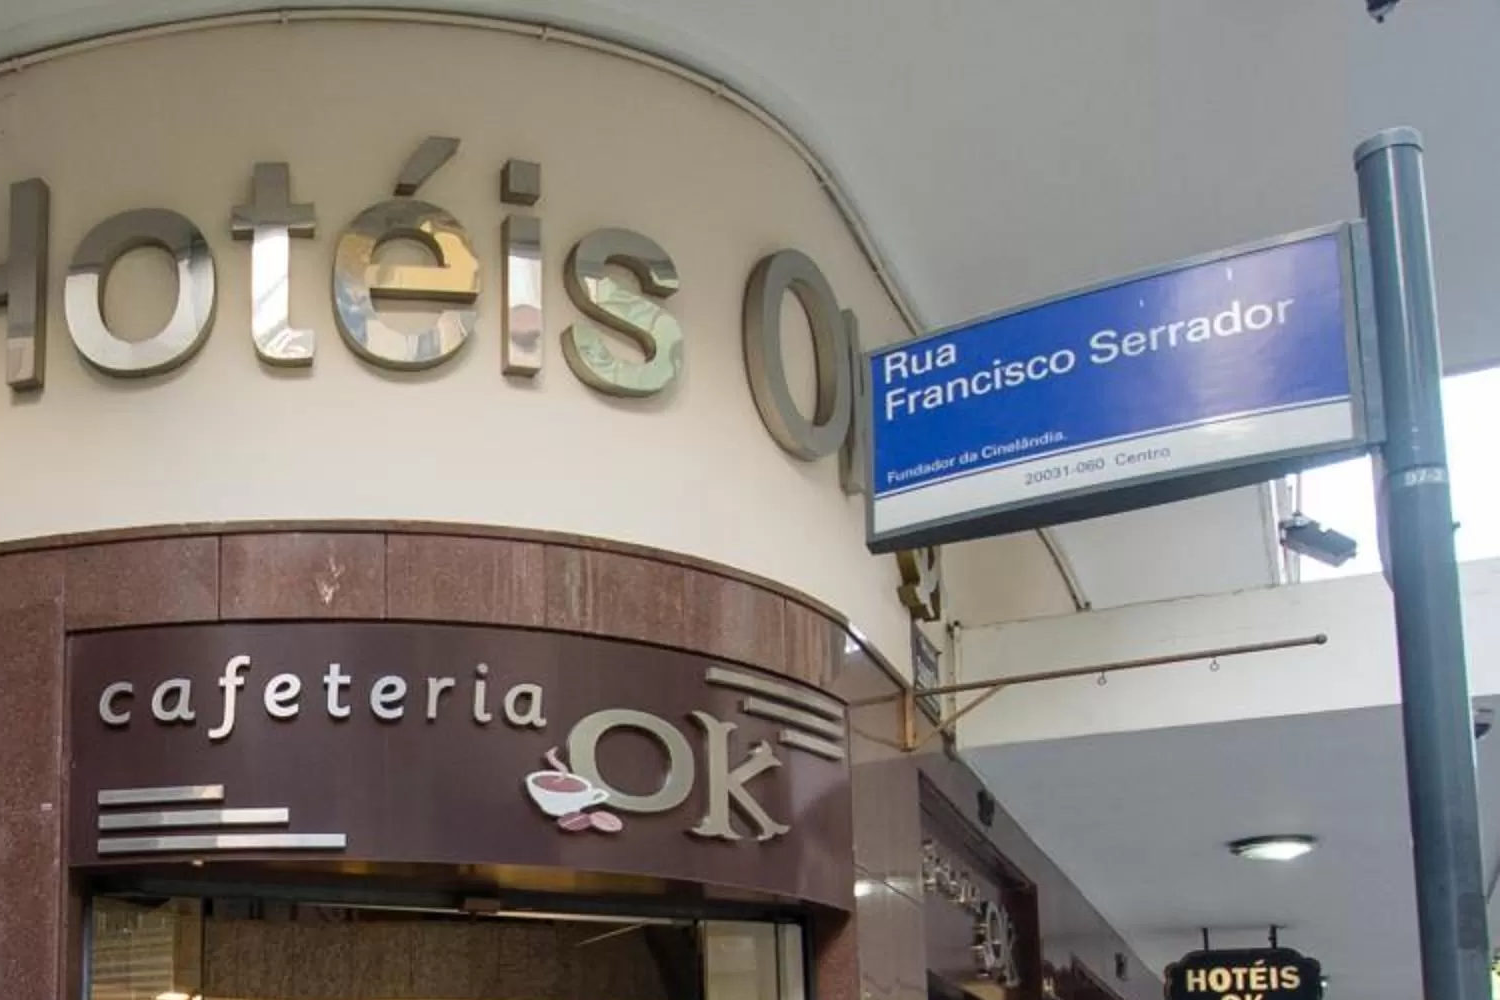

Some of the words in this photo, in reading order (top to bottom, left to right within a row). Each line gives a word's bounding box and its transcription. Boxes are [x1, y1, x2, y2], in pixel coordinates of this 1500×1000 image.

[741, 247, 866, 496] O
[884, 342, 957, 385] Rua
[885, 347, 1077, 421] Francisco
[1088, 295, 1297, 366] Serrador
[887, 455, 956, 485] Fundador
[959, 447, 980, 465] da
[1024, 457, 1106, 486] 20031-060
[1114, 445, 1171, 468] Centro
[98, 654, 548, 740] cafeteria
[567, 707, 792, 842] OK
[1186, 960, 1301, 992] HOTÉIS
